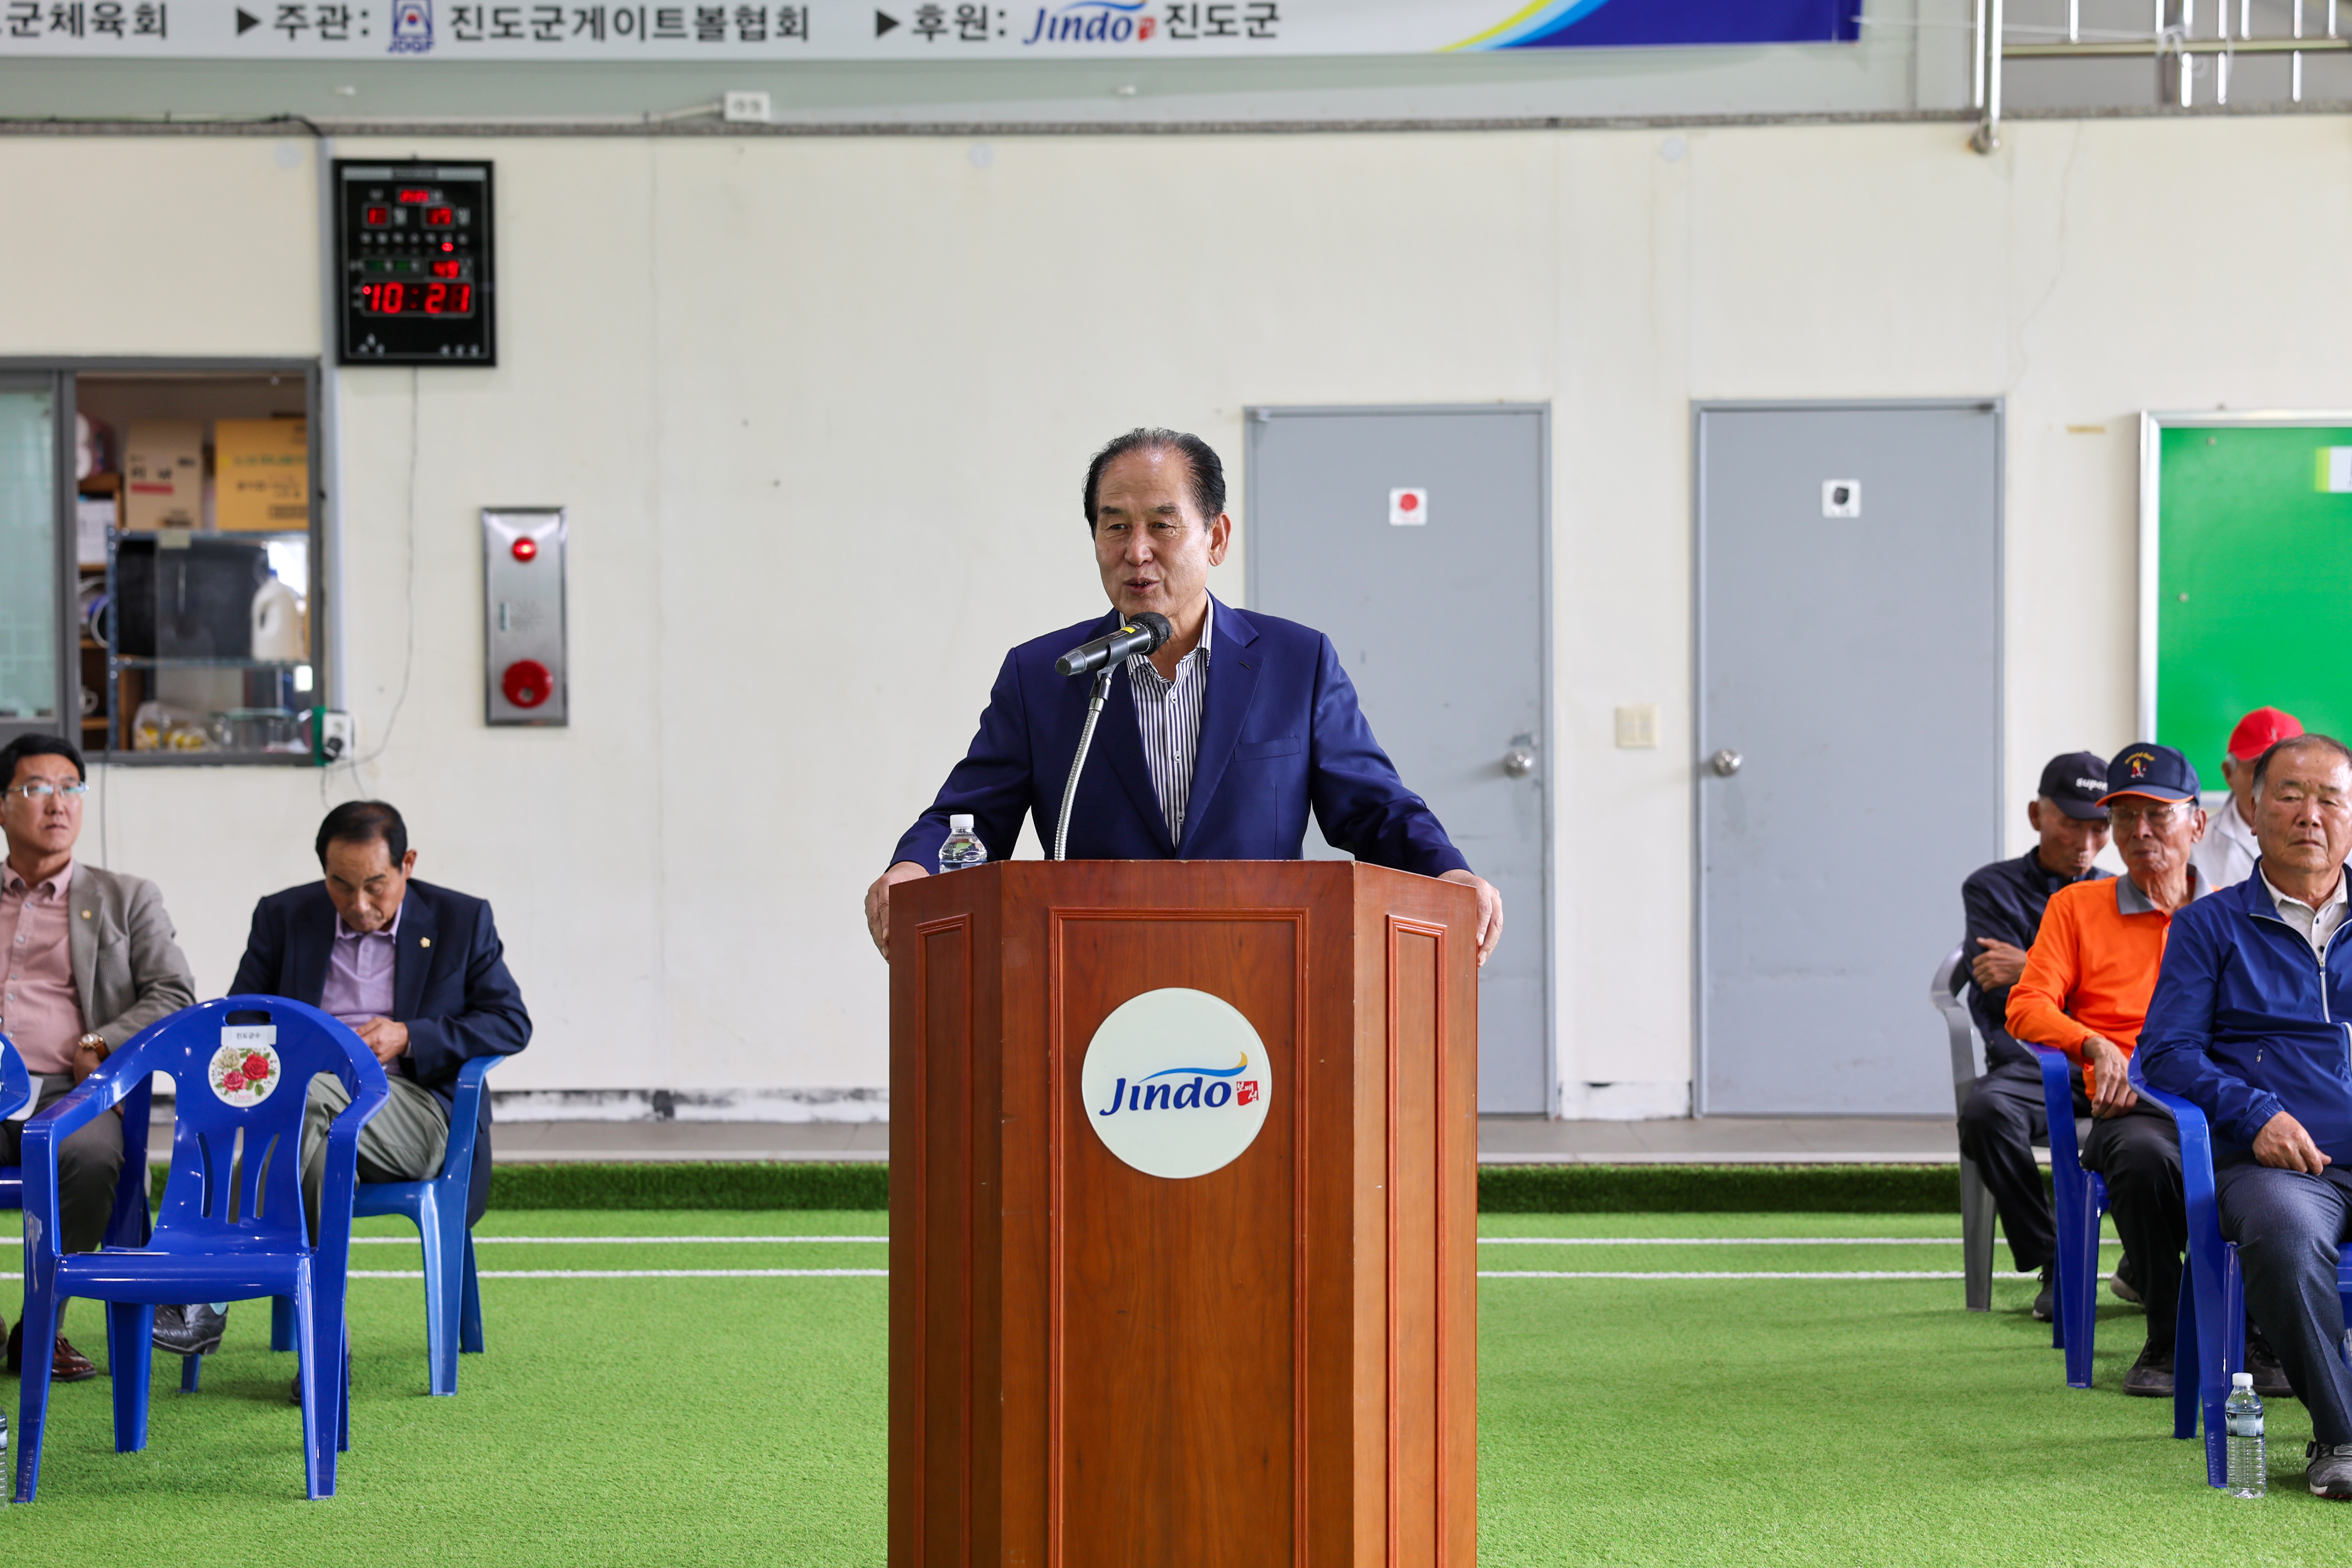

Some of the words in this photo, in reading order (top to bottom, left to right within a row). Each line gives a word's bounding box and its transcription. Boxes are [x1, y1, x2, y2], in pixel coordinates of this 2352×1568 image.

[0, 3, 166, 38] 군체육회
[275, 5, 368, 39] 주관:
[451, 6, 808, 41] 진도군게이트볼협회
[913, 5, 1005, 41] 후원:
[1024, 8, 1132, 44] Jindo
[1166, 4, 1278, 38] 진도군
[371, 282, 470, 314] 10:21
[1099, 1076, 1232, 1116] Jindo
